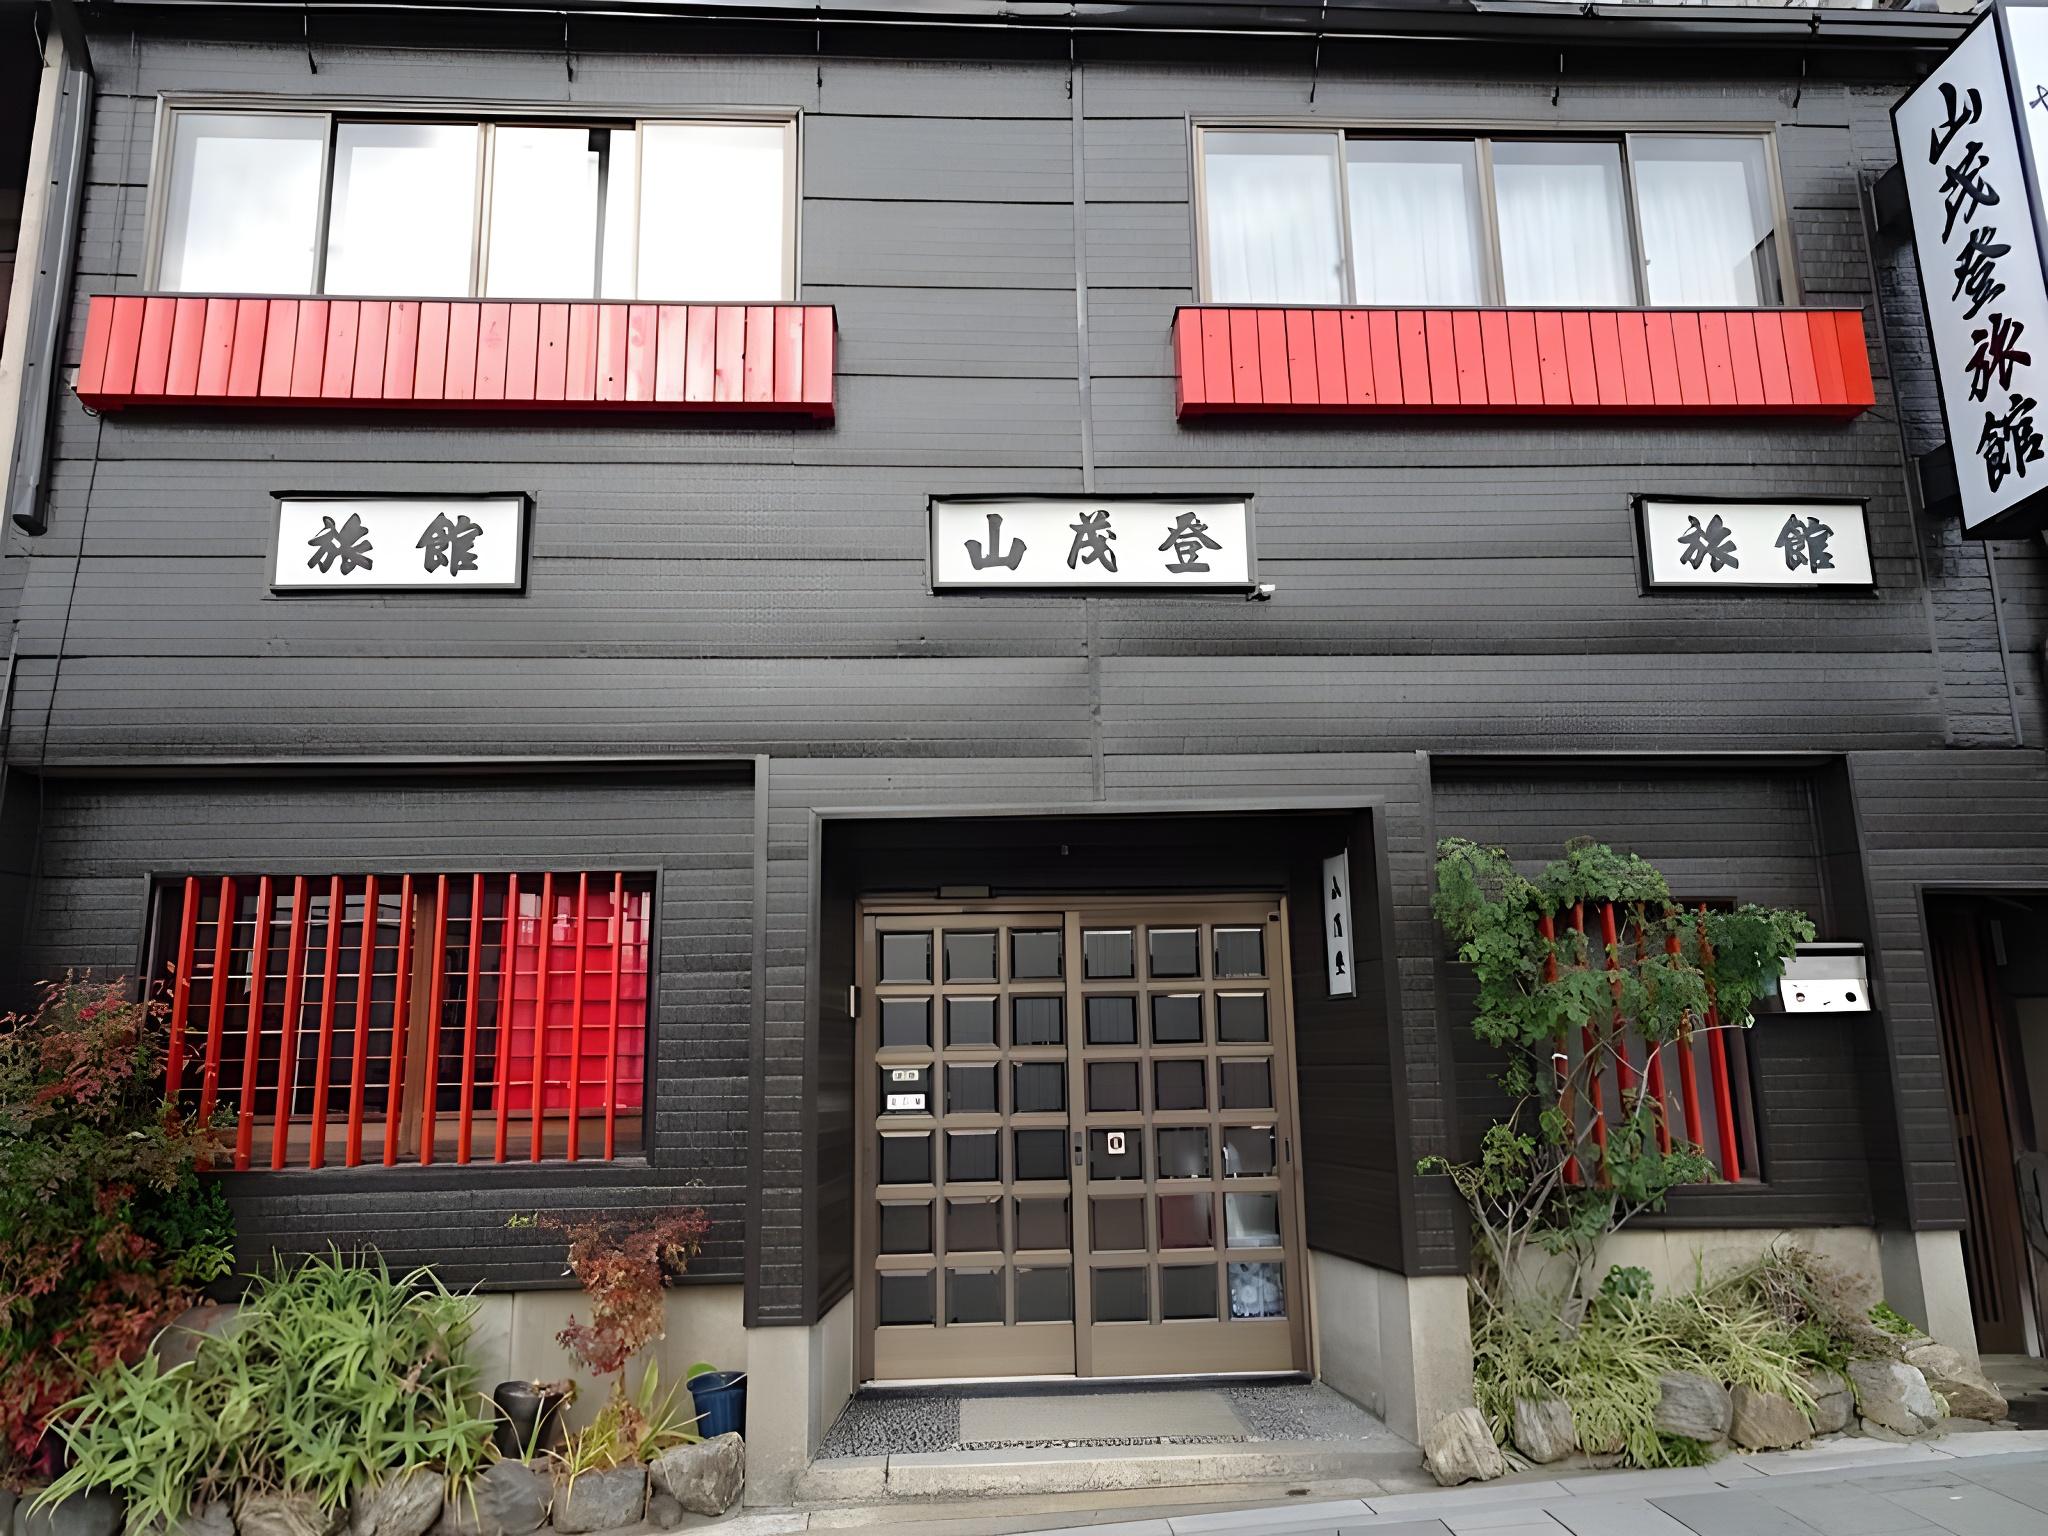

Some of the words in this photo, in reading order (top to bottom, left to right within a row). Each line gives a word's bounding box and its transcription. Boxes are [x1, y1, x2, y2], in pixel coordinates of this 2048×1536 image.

[1929, 83, 2044, 493] 山茂登旅館
[307, 512, 484, 577] 旅館
[964, 510, 1223, 574] 山茂登
[1677, 514, 1836, 574] 旅館
